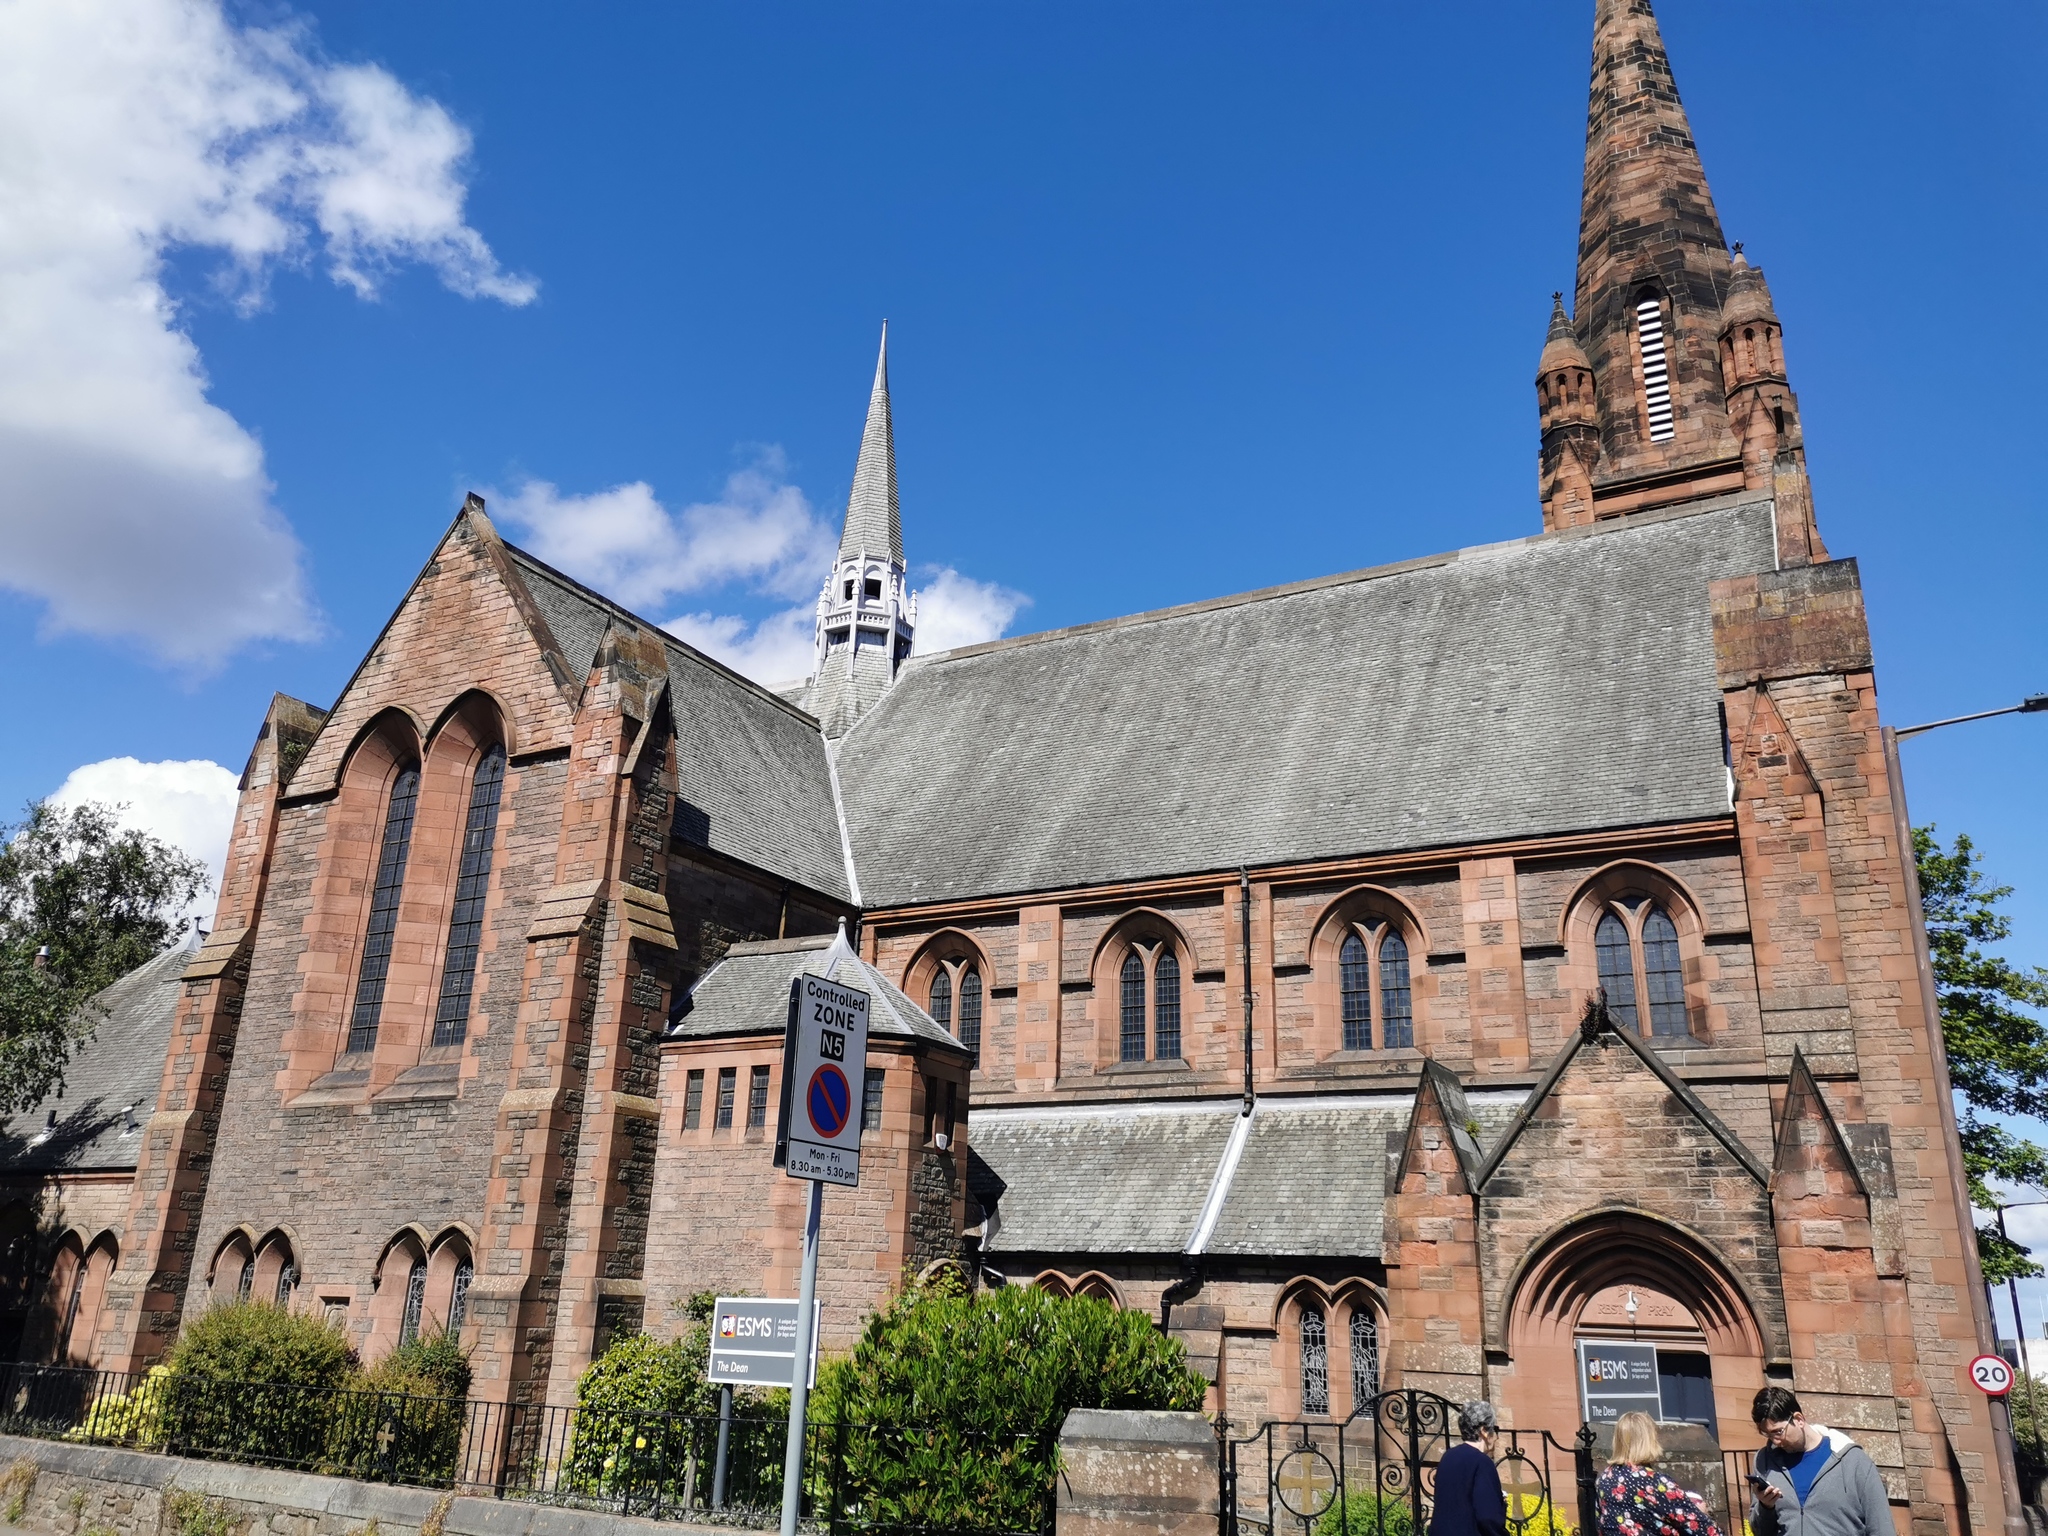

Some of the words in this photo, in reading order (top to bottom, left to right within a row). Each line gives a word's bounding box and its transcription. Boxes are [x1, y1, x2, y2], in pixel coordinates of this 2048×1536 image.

[807, 980, 865, 1012] Controlled
[814, 1003, 855, 1032] ZONE
[821, 1033, 843, 1057] N5
[809, 1148, 825, 1160] Mon
[830, 1152, 840, 1163] Fri
[790, 1159, 809, 1172] 8.30
[810, 1165, 821, 1174] am
[826, 1166, 844, 1178] 5.30
[844, 1170, 855, 1180] pm
[1646, 1305, 1675, 1316] PRAY
[736, 1316, 772, 1338] ESMS
[717, 1361, 729, 1372] The
[730, 1361, 748, 1373] Dean
[1601, 1360, 1628, 1380] ESMS
[1975, 1366, 2006, 1383] 20
[1592, 1405, 1602, 1416] The
[1603, 1405, 1617, 1416] Dean
